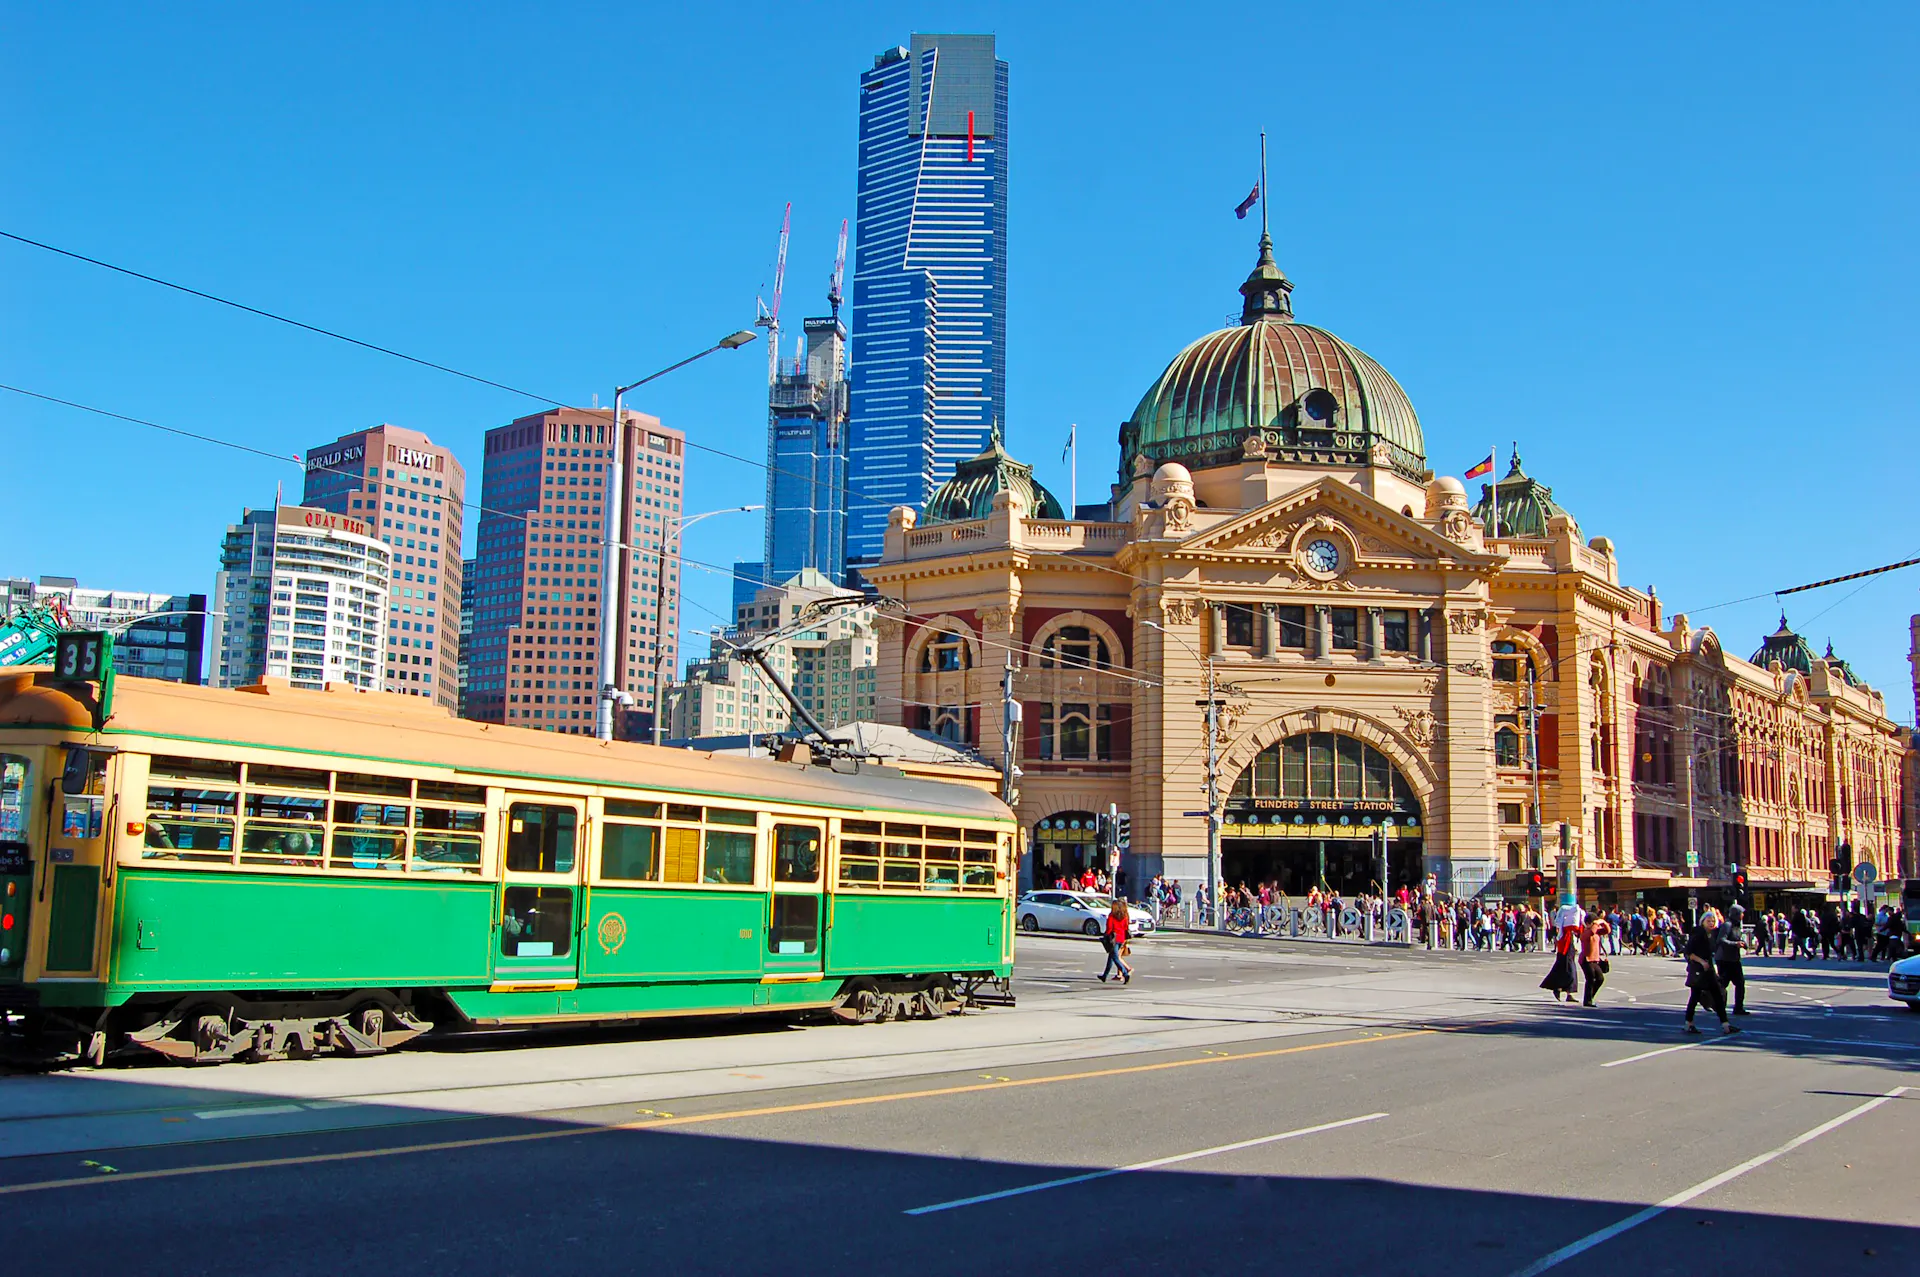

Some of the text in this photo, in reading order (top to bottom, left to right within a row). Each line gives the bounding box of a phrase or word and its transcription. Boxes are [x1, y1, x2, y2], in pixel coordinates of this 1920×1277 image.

[344, 445, 364, 461] SUN
[399, 447, 435, 468] HWT
[305, 512, 365, 535] QUAY WEST
[64, 641, 97, 675] 35
[1255, 800, 1394, 811] FLINDERS STREET STATION
